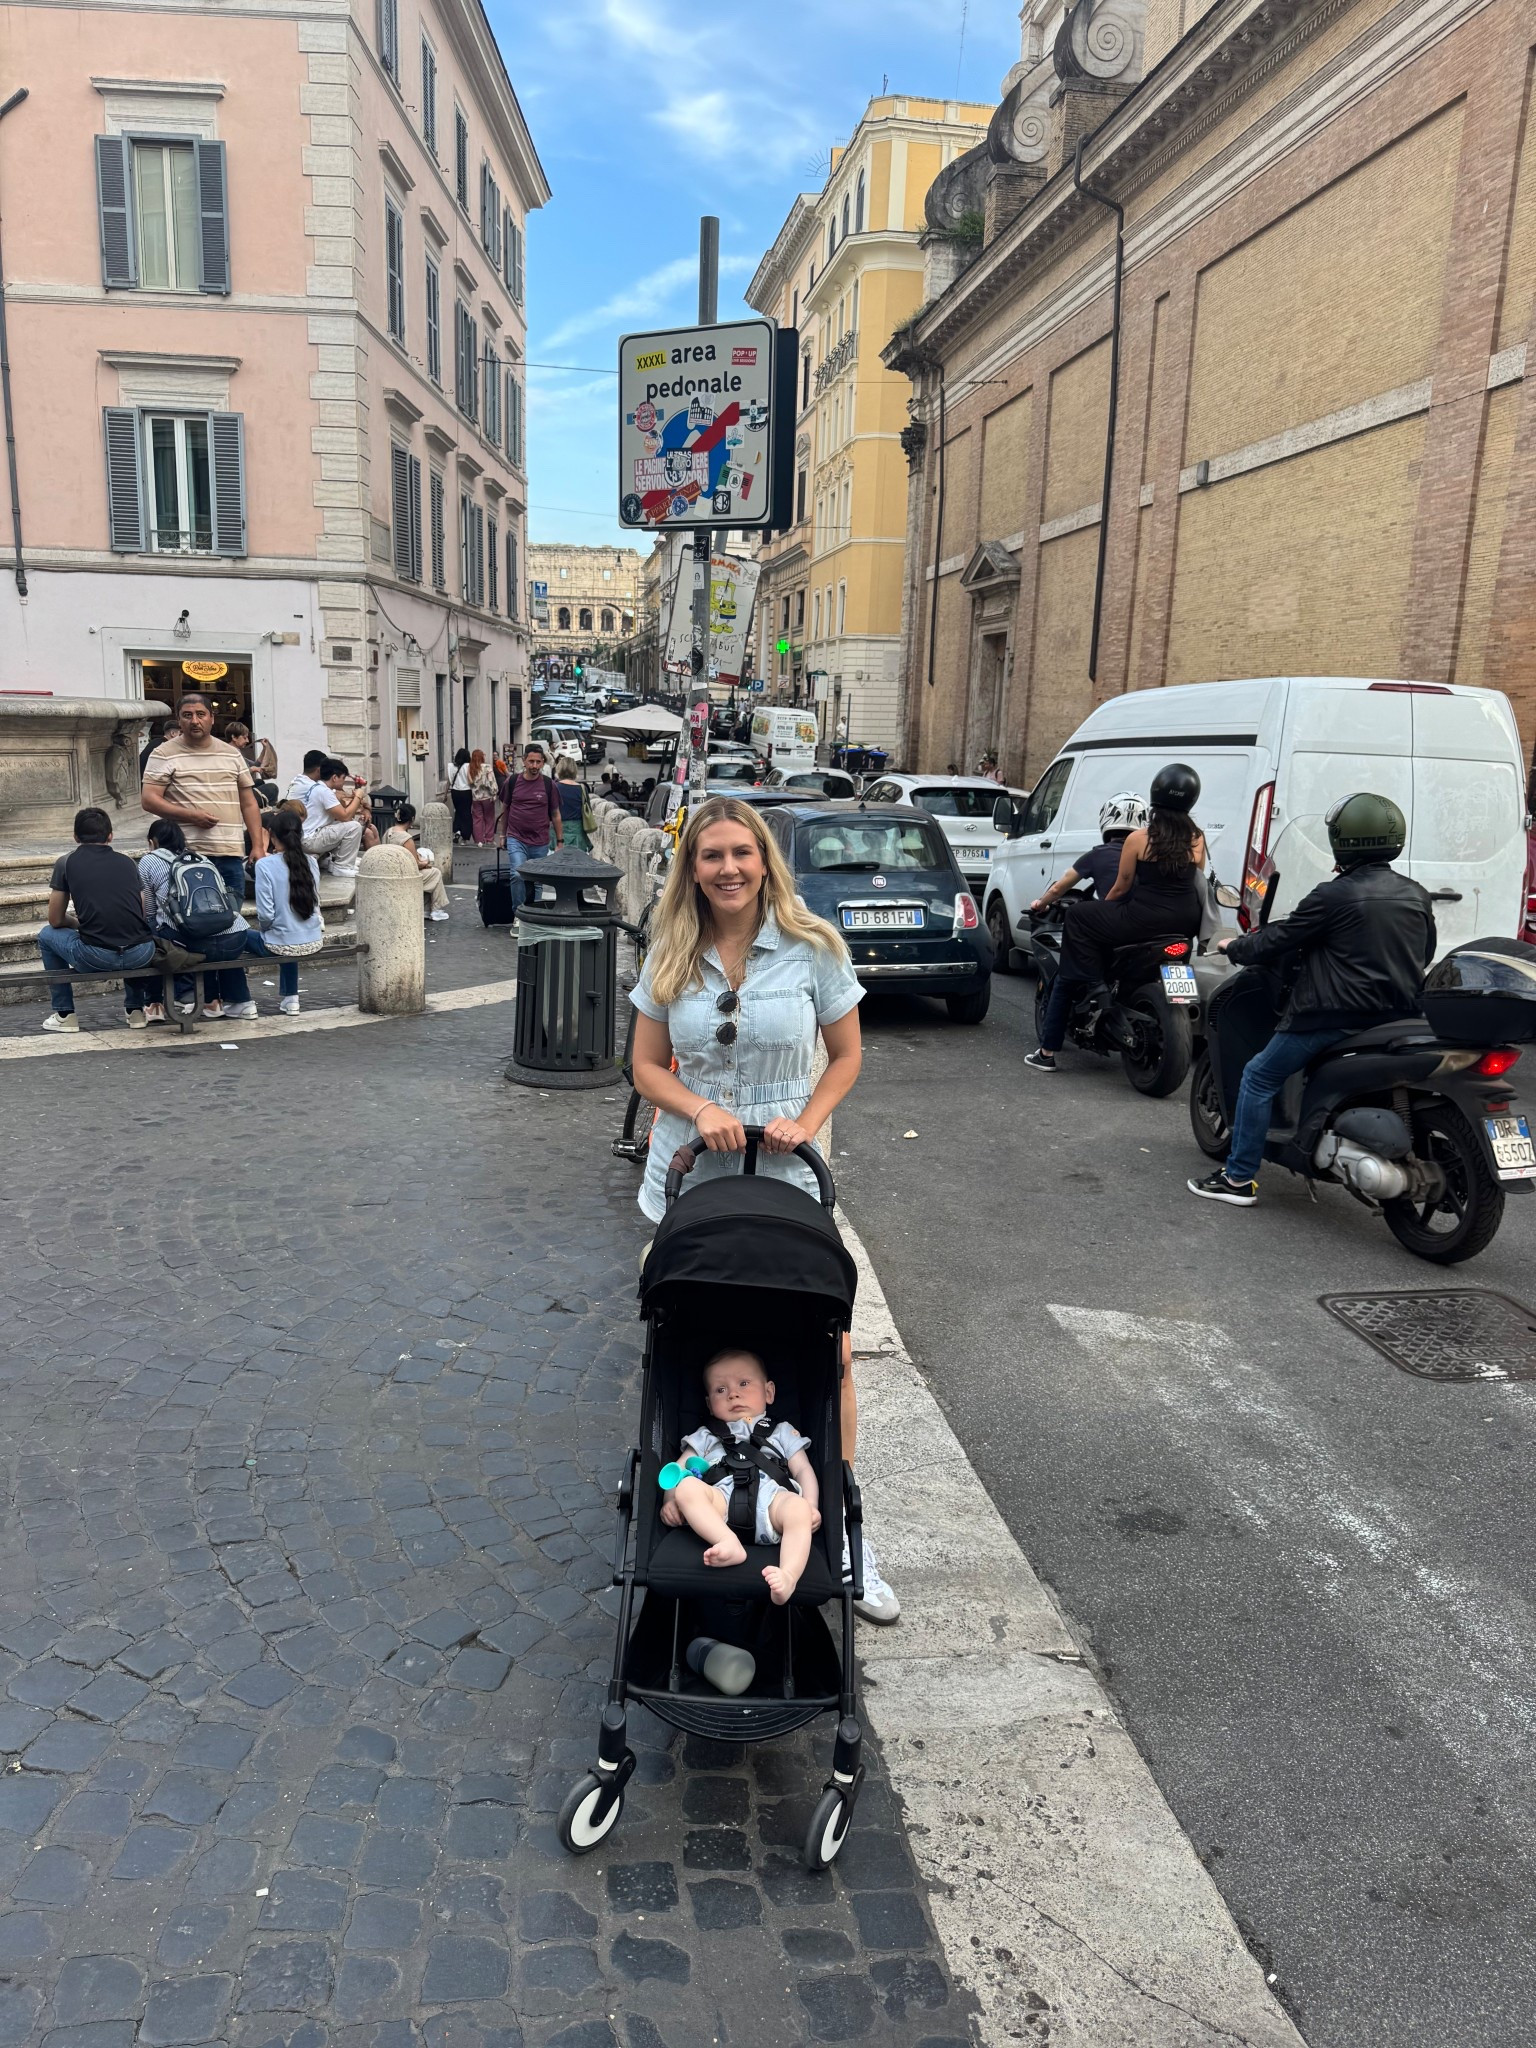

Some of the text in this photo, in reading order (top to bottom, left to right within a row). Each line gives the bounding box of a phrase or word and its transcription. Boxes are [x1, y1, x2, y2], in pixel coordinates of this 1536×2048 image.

[636, 353, 666, 370] XXXXL
[671, 344, 716, 364] area
[646, 371, 742, 403] pedonale
[962, 849, 984, 858] 876SA
[853, 911, 914, 925] FD 681FW
[1165, 981, 1195, 994] 20801
